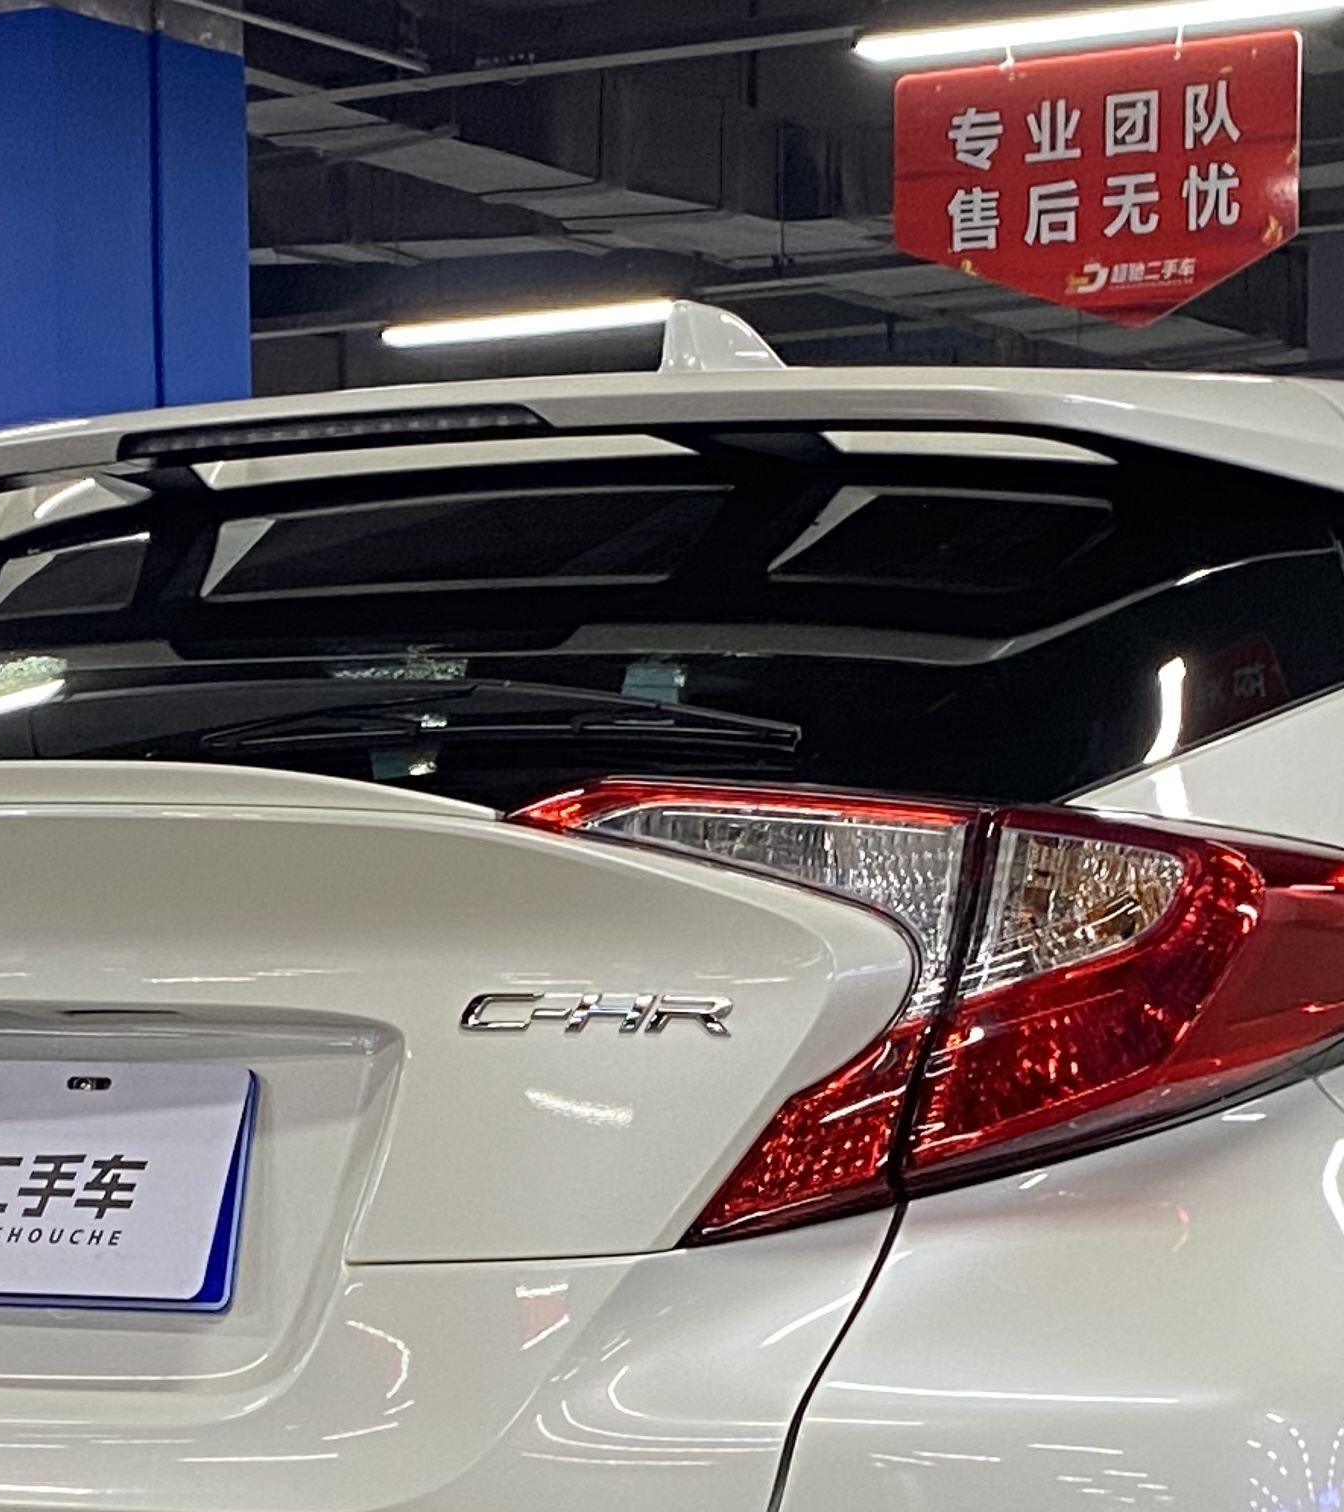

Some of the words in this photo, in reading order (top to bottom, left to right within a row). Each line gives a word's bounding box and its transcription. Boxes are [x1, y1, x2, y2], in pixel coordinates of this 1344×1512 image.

[948, 79, 1241, 171] 专业团队
[947, 161, 1240, 253] 售后无忧
[459, 993, 735, 1037] C-HR
